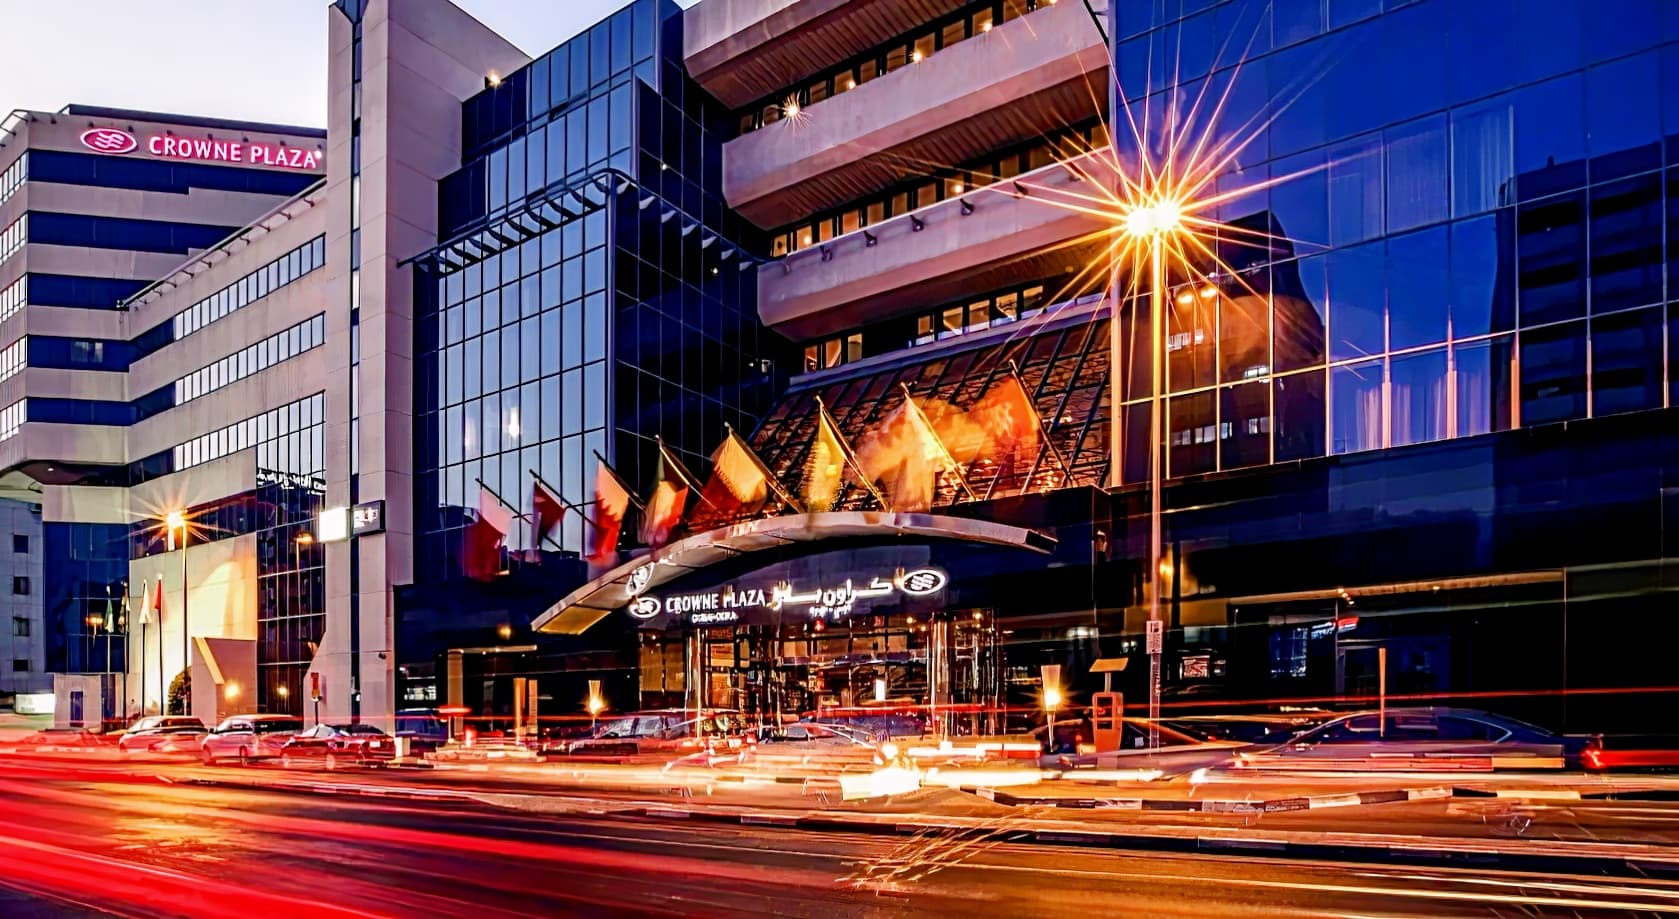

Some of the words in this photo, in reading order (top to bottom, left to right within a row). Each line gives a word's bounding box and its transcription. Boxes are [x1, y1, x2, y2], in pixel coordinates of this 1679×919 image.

[148, 136, 242, 162] CROWNE
[250, 145, 318, 169] PLAZA
[665, 593, 719, 614] CROWNE
[723, 588, 766, 609] PLAZA
